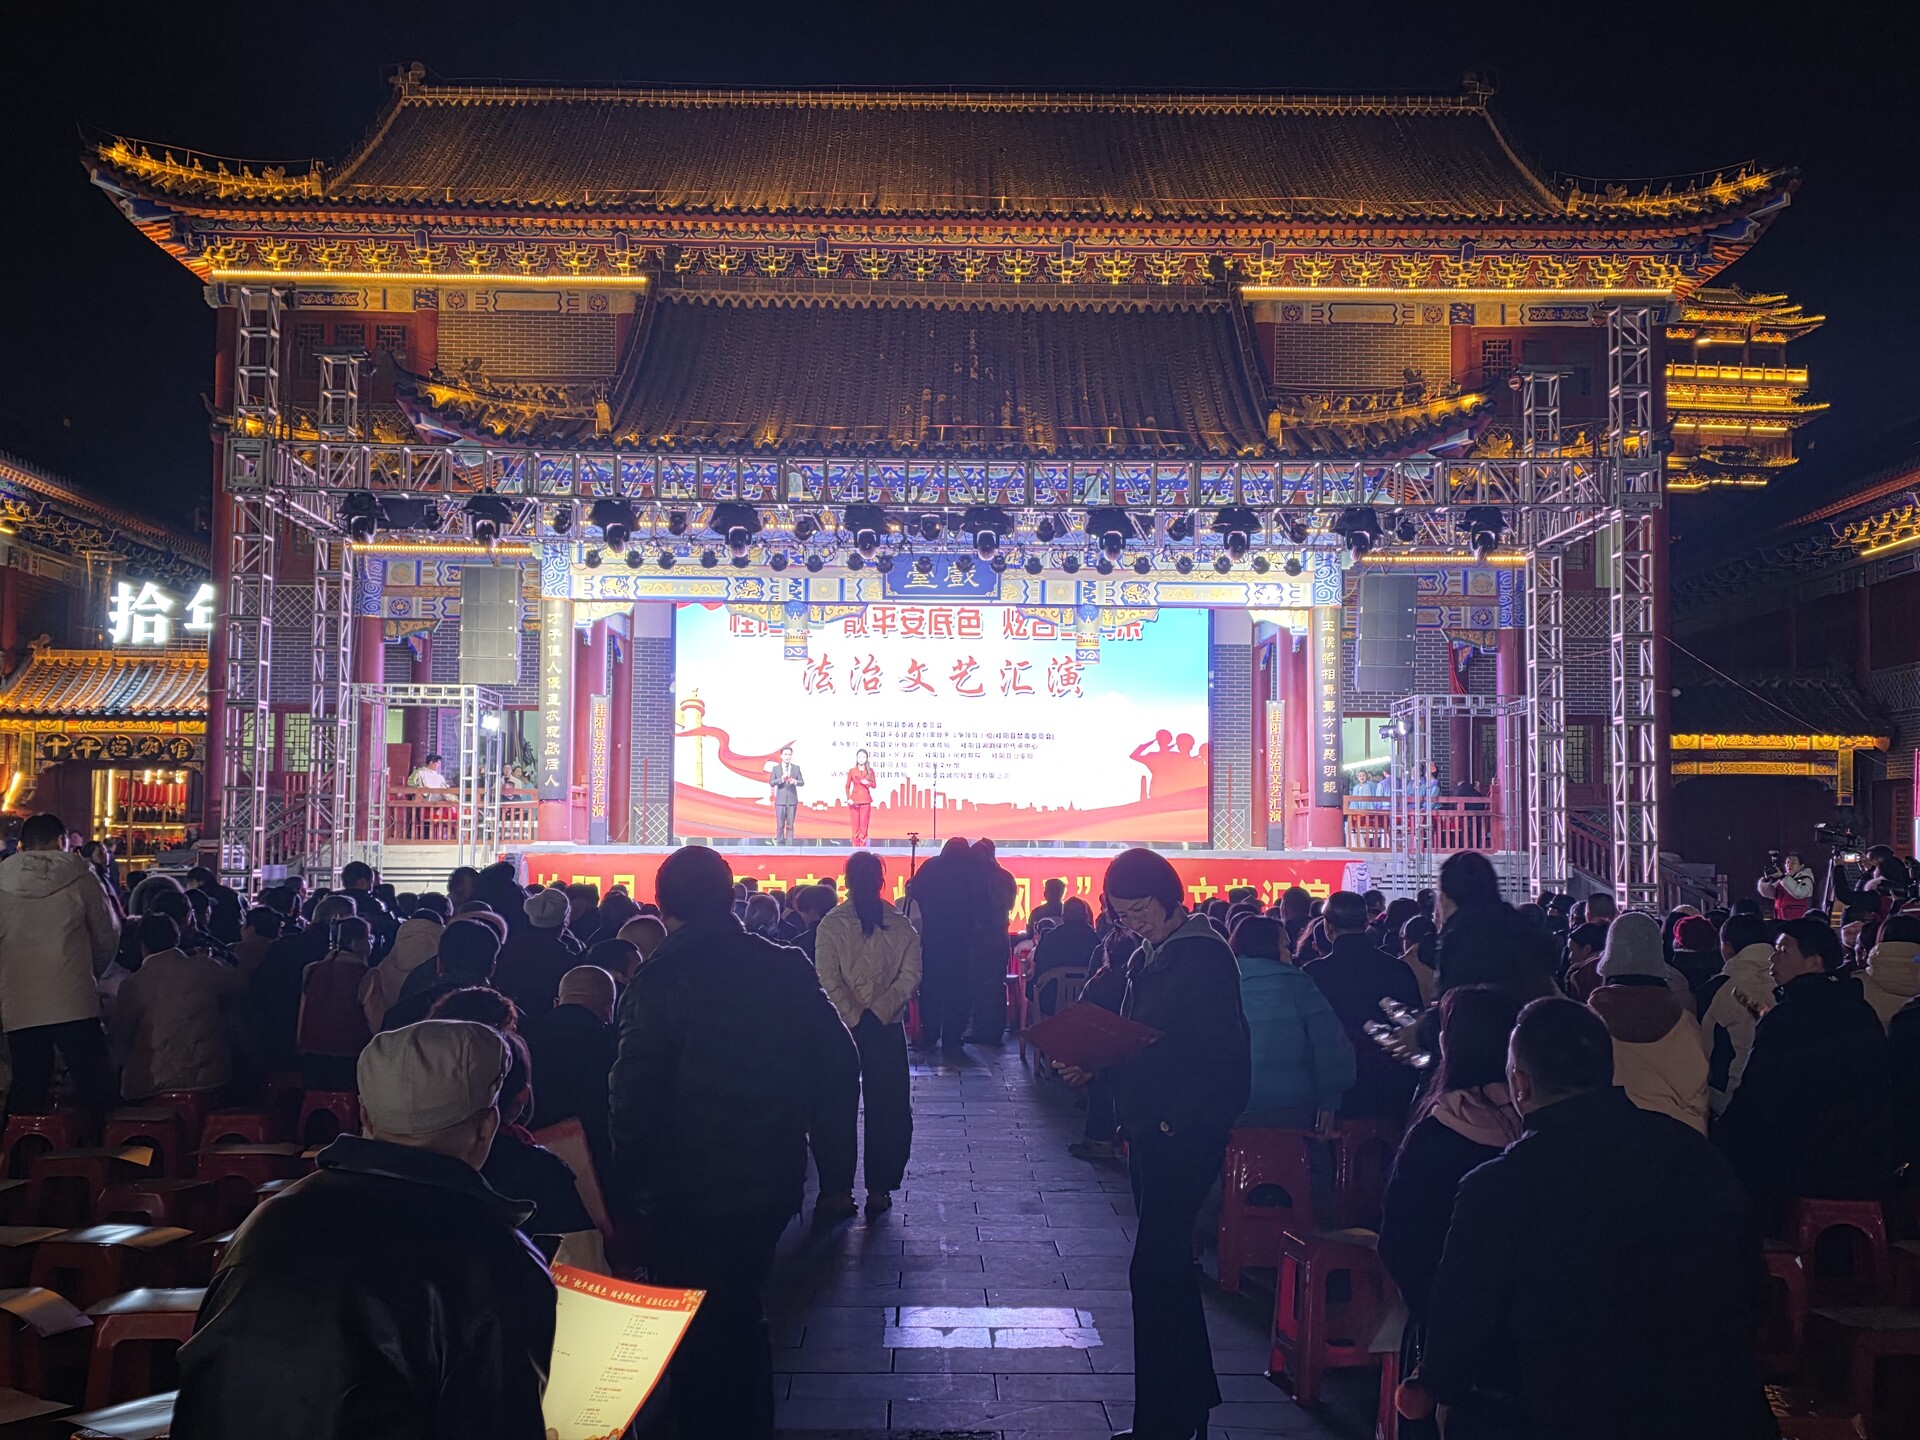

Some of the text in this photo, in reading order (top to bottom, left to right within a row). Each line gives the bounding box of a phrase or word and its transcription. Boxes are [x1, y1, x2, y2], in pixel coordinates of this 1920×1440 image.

[801, 652, 1086, 698] 法治文艺汇演
[592, 703, 607, 819] 桂阳县法治文艺汇演
[1268, 709, 1283, 823] 桂阳县法治文艺汇演
